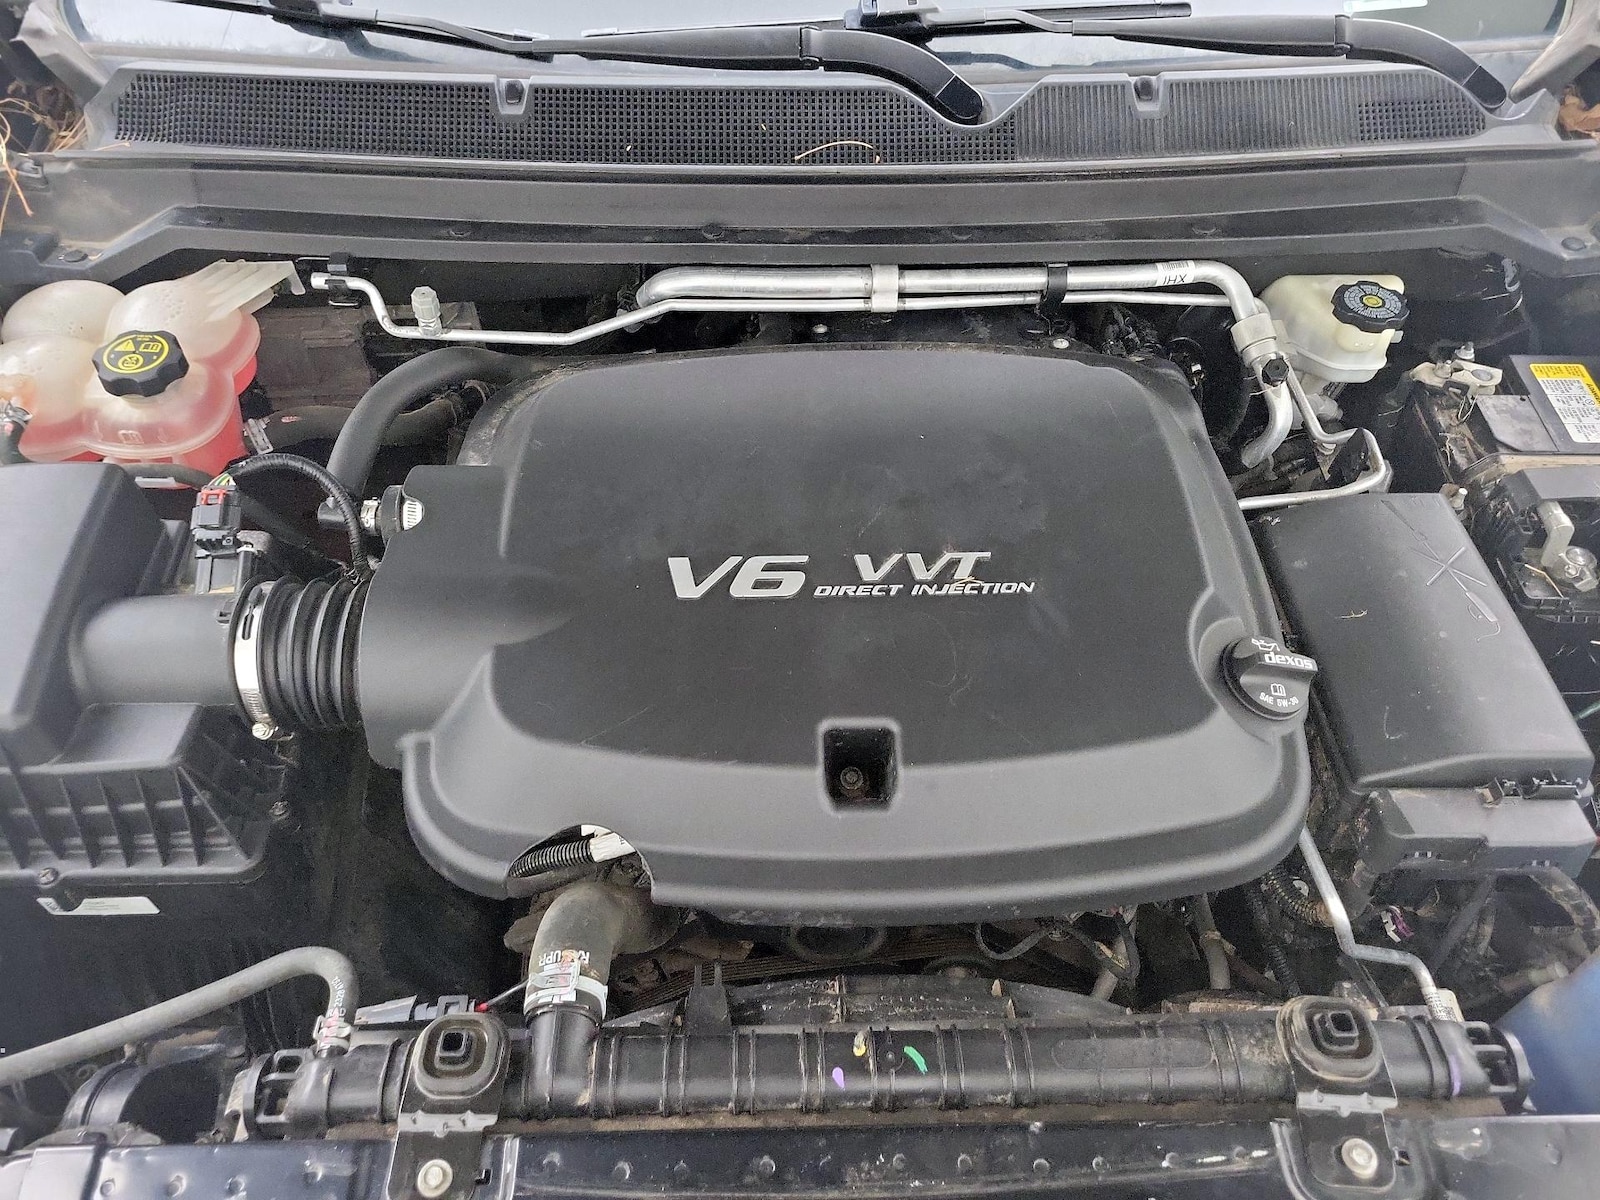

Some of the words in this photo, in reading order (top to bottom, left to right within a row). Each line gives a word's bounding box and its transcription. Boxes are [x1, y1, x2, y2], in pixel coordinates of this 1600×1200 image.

[853, 551, 992, 581] VVT
[667, 555, 810, 599] V6
[813, 585, 903, 597] DIRECT
[911, 581, 1036, 596] INJECTION
[1264, 652, 1313, 669] dexos
[1259, 692, 1274, 705] SAE
[1276, 696, 1299, 708] 5W-30
